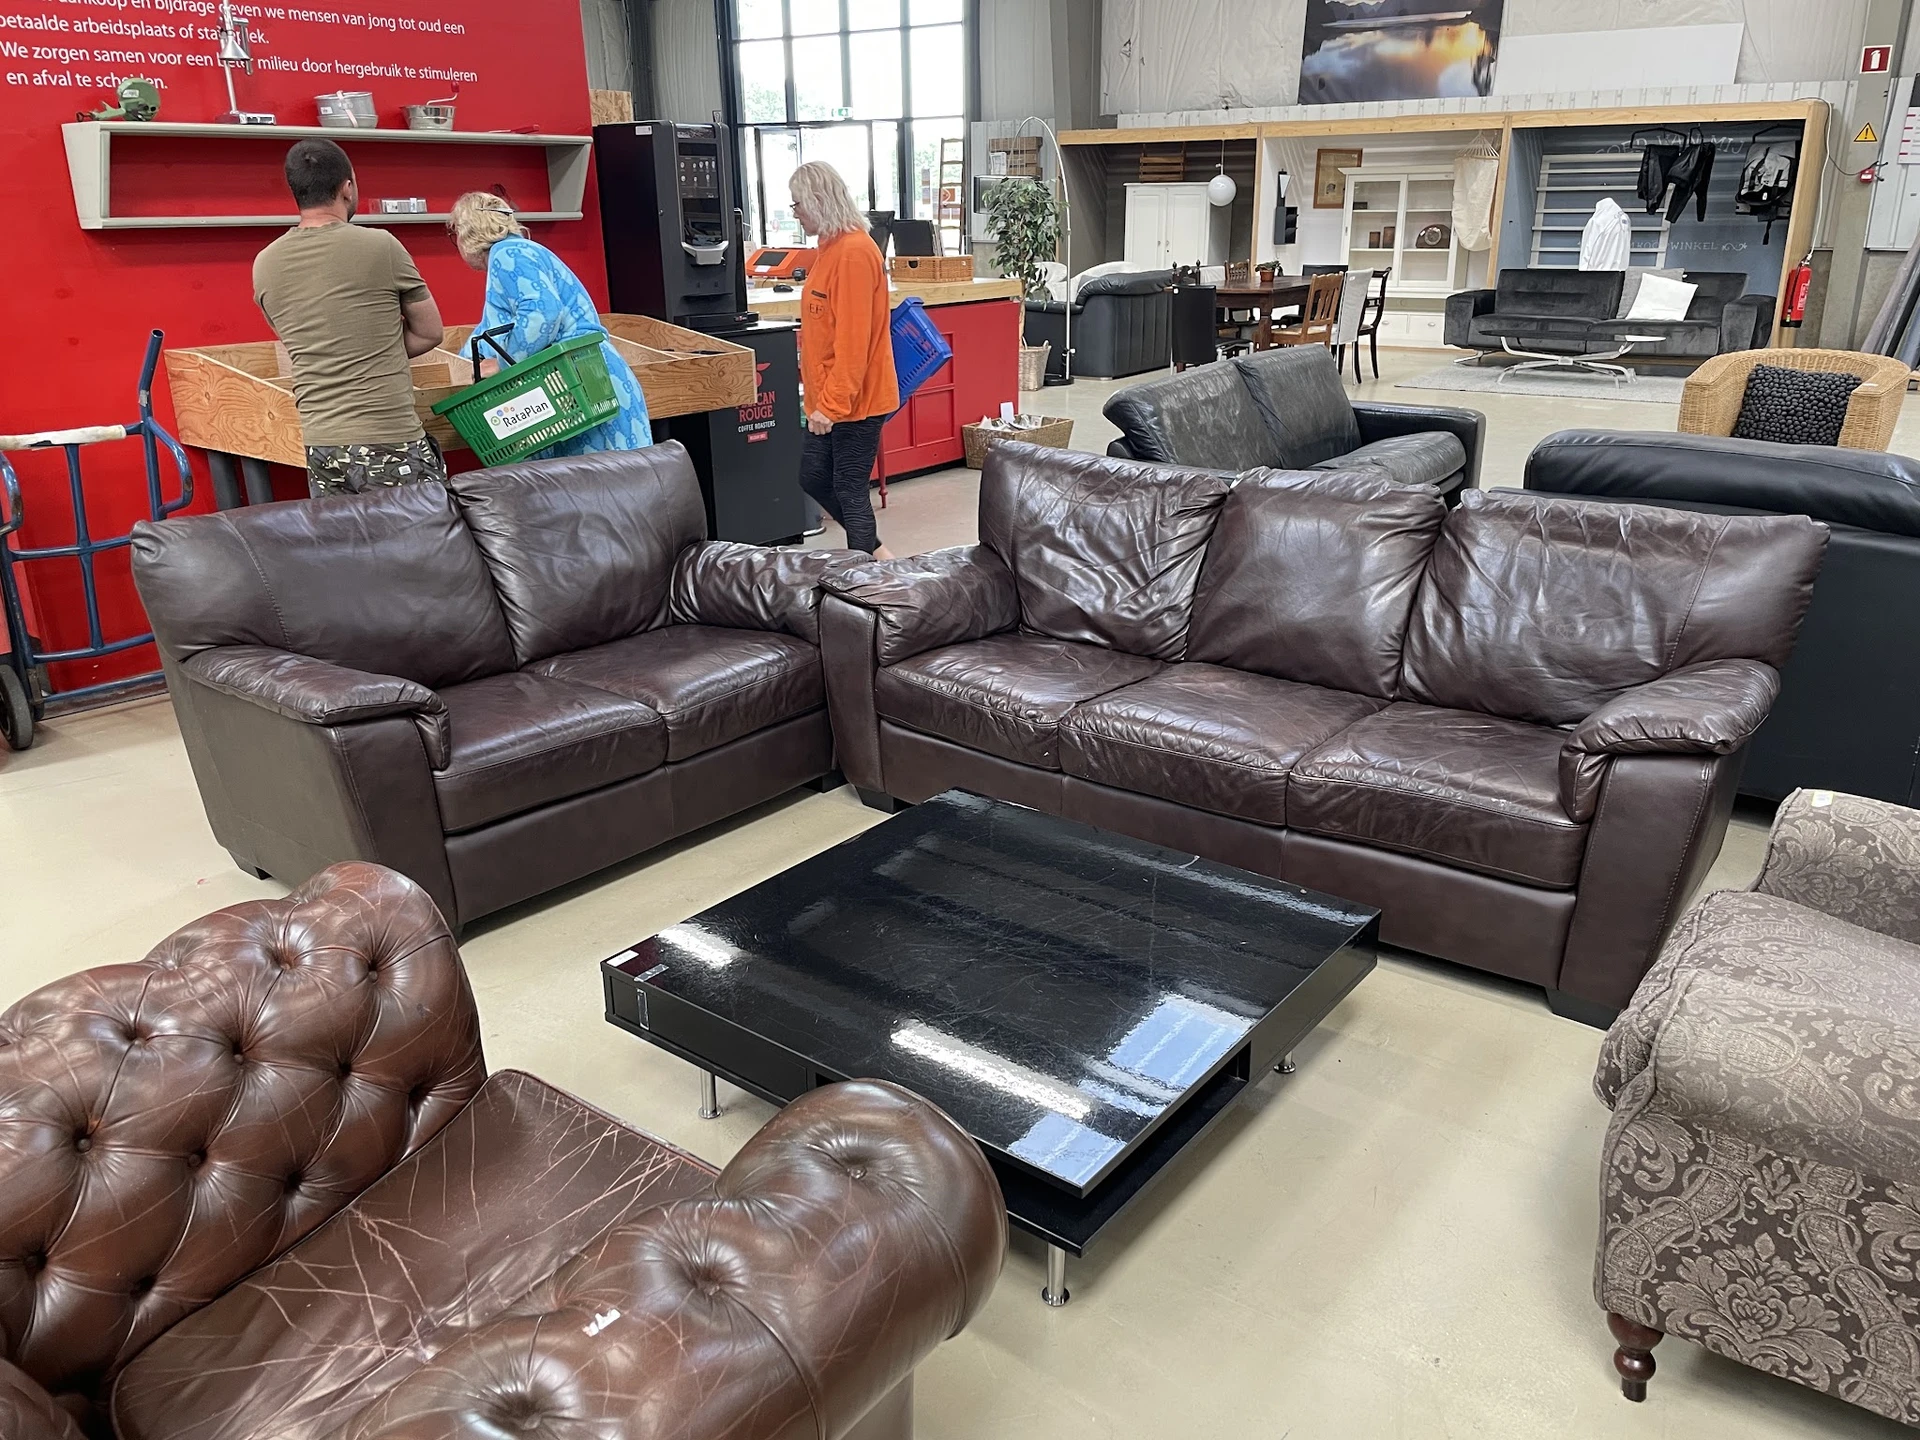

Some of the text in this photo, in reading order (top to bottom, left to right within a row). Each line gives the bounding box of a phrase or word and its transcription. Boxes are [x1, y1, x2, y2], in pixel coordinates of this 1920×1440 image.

[73, 16, 176, 39] arbeidsplaats
[178, 23, 194, 39] of
[197, 26, 270, 45] stalek.
[264, 7, 285, 19] we
[288, 9, 340, 24] mensen
[342, 13, 366, 26] van
[367, 13, 396, 32] jong
[399, 17, 416, 31] tot
[418, 19, 442, 33] oud
[443, 22, 466, 35] een
[0, 41, 29, 59] We
[31, 46, 90, 64] zorgen
[93, 49, 145, 64] samen
[148, 52, 182, 66] voor
[186, 54, 213, 67] een
[257, 56, 299, 72] milieu
[301, 58, 332, 74] door
[334, 60, 402, 79] hergebruik
[403, 66, 417, 79] te
[419, 67, 478, 83] stimuleren
[6, 69, 168, 89] en afval te schen.
[502, 402, 549, 428] RataPlan
[738, 420, 776, 433] COFFEE ROASTERS
[739, 405, 773, 422] ROUGE
